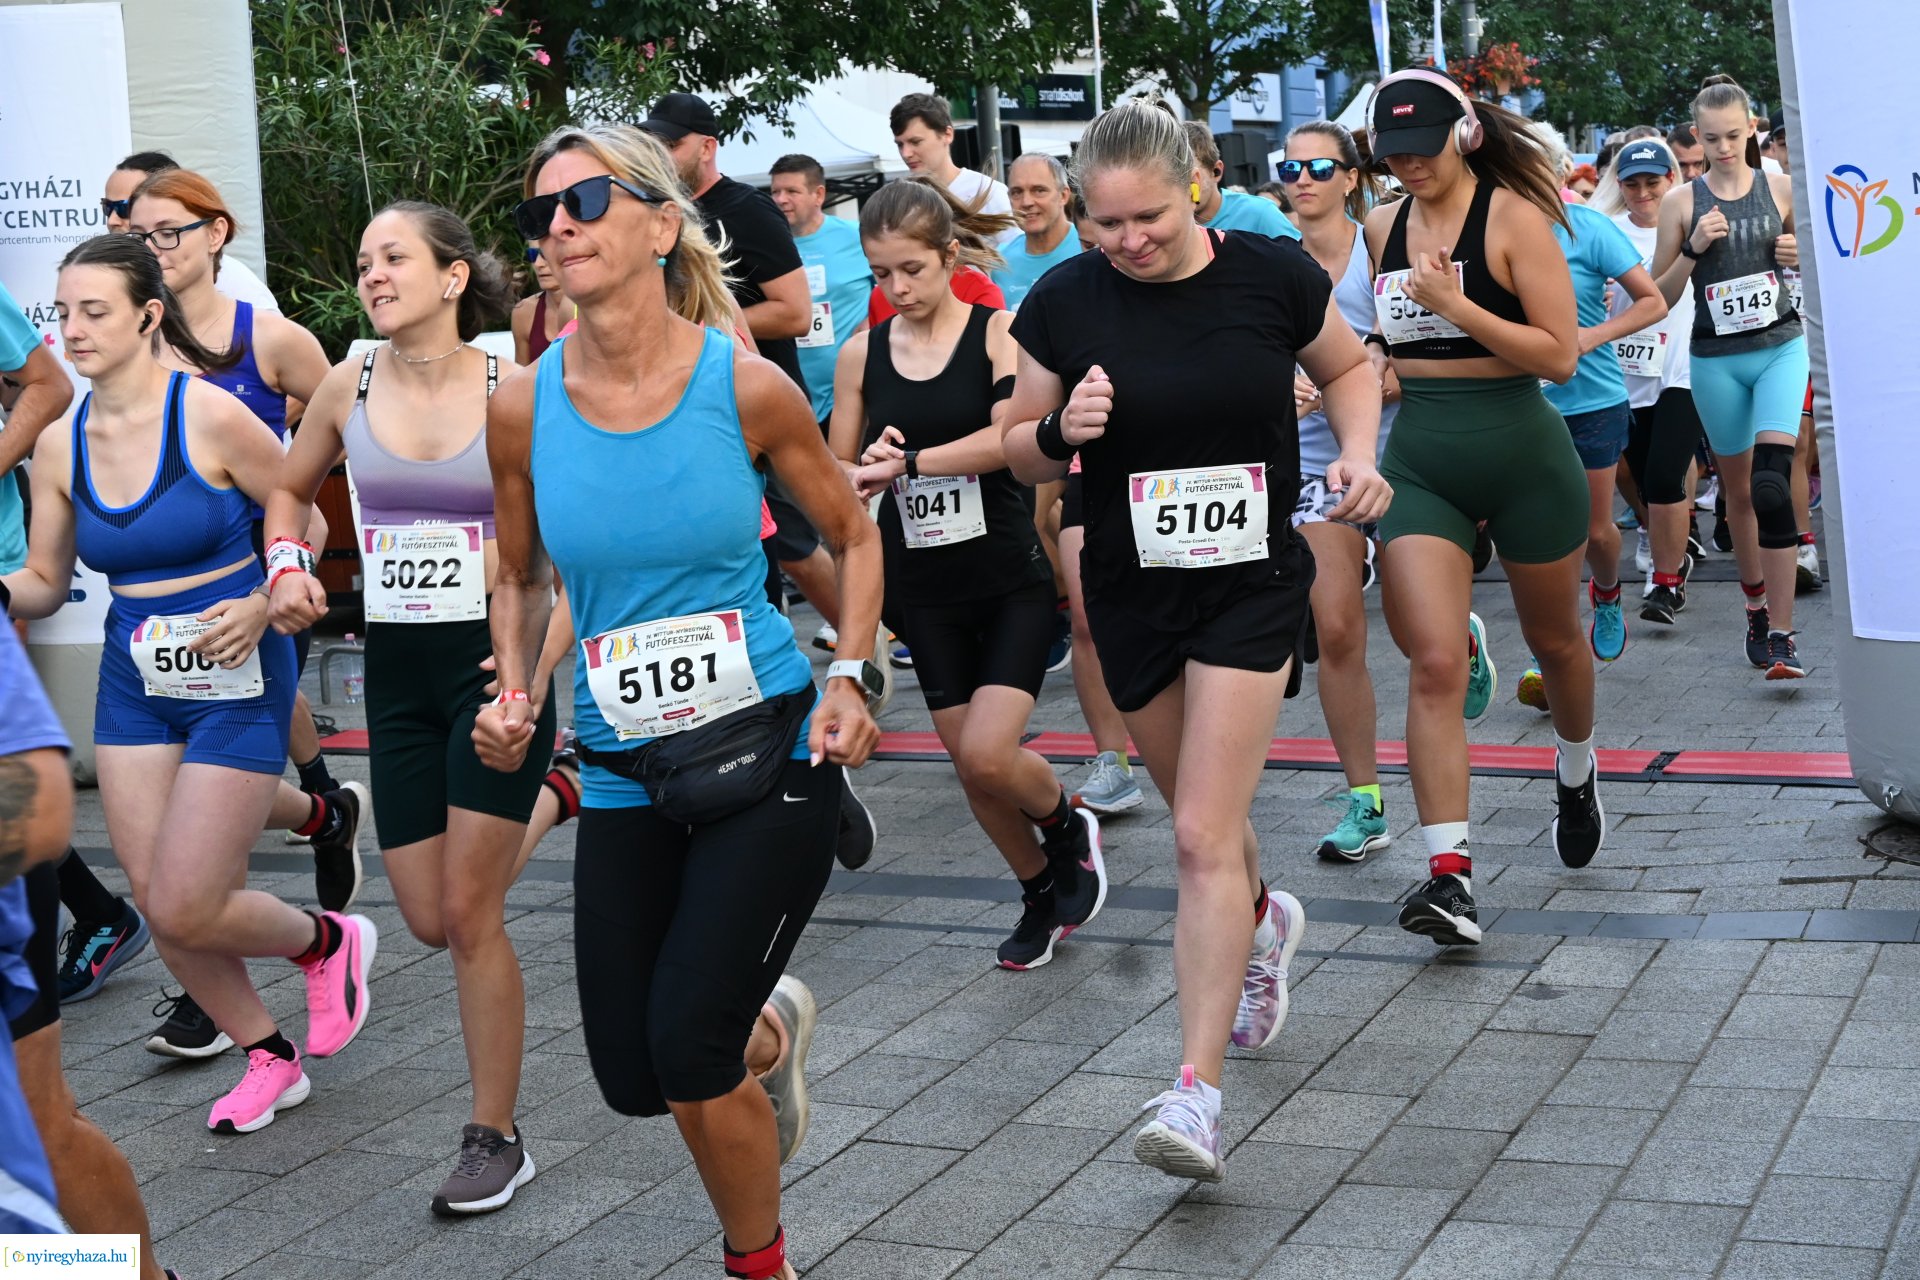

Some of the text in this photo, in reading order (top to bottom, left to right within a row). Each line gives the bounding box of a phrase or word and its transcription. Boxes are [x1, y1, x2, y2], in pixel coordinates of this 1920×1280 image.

[0, 208, 107, 228] CENTRU
[1723, 290, 1772, 316] 5143
[1617, 343, 1655, 361] 5071
[1185, 481, 1245, 493] FUTÓFESZTIVÁL
[905, 488, 961, 520] 5041
[1156, 499, 1248, 536] 5104
[381, 557, 462, 589] 5022
[645, 630, 716, 650] FUTÓFESZTIVÁL
[619, 652, 717, 704] 5181
[717, 752, 757, 775] HEAVY TOOLS
